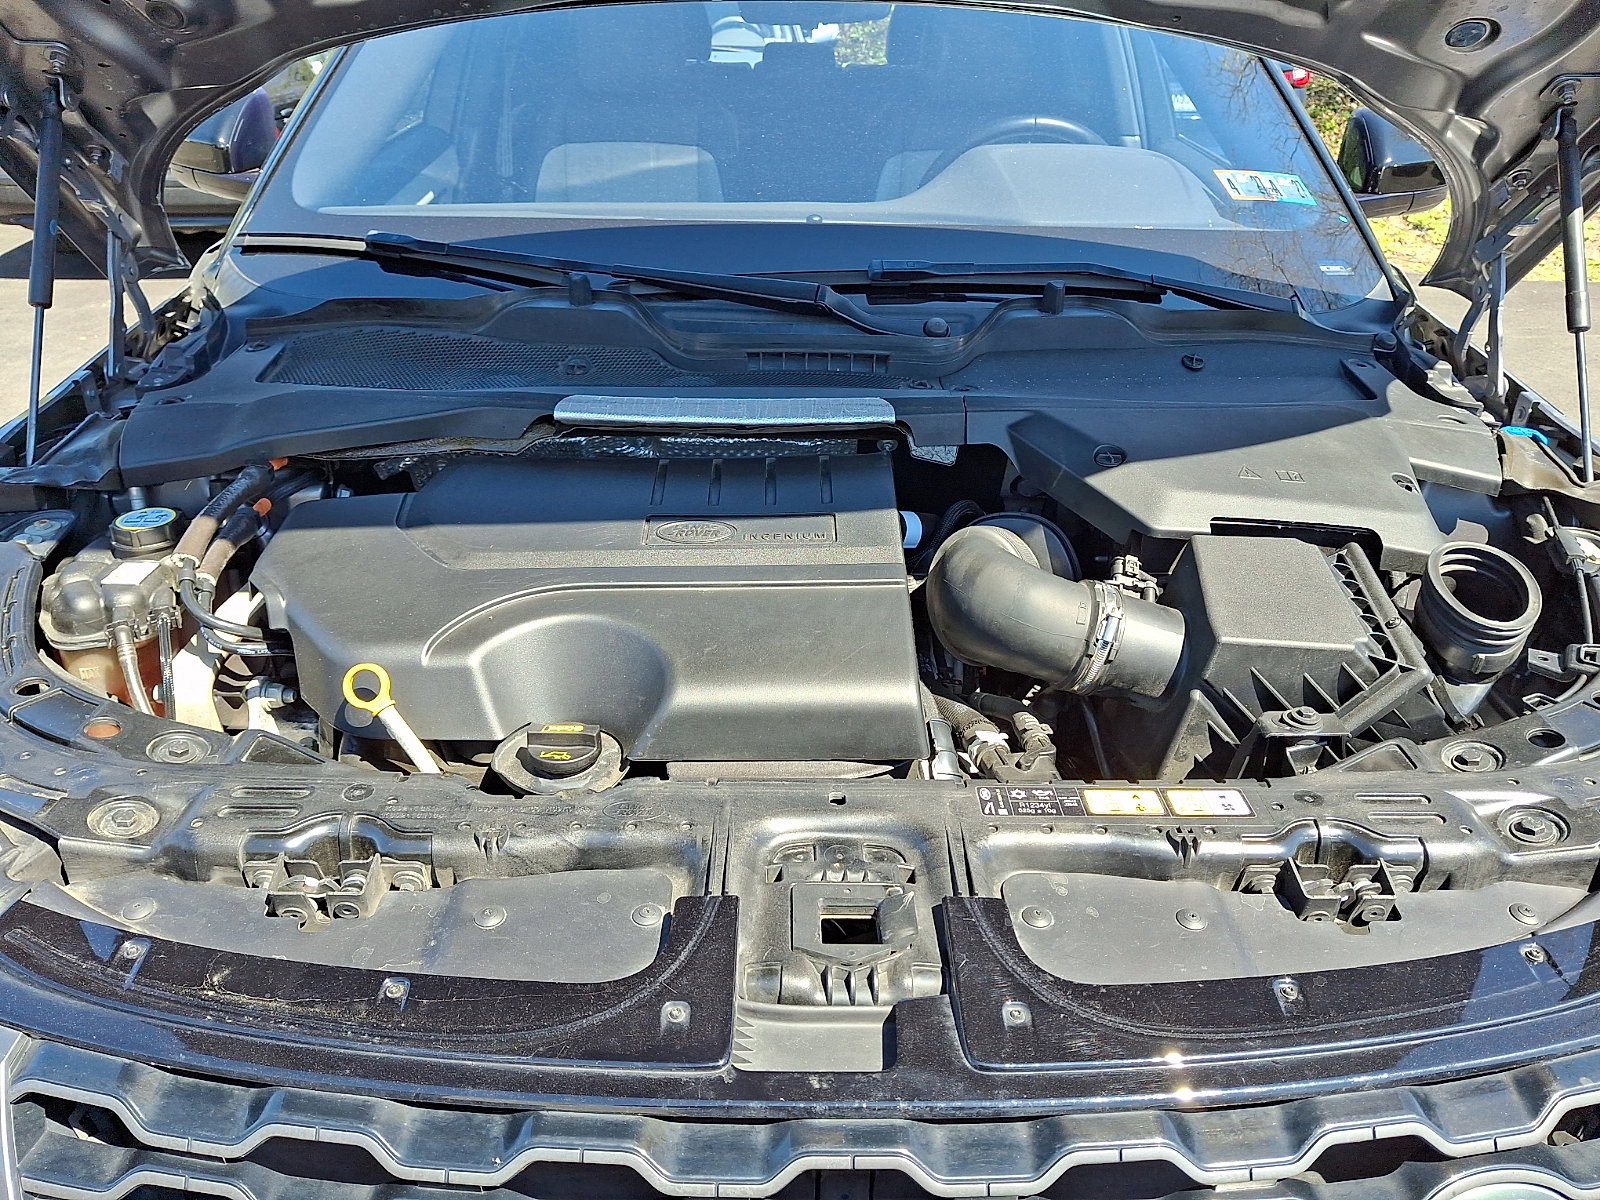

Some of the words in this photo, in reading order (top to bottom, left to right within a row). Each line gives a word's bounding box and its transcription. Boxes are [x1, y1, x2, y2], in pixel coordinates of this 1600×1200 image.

[1227, 178, 1241, 195] 4
[677, 529, 721, 537] ROVER
[742, 532, 827, 541] INGENIUM
